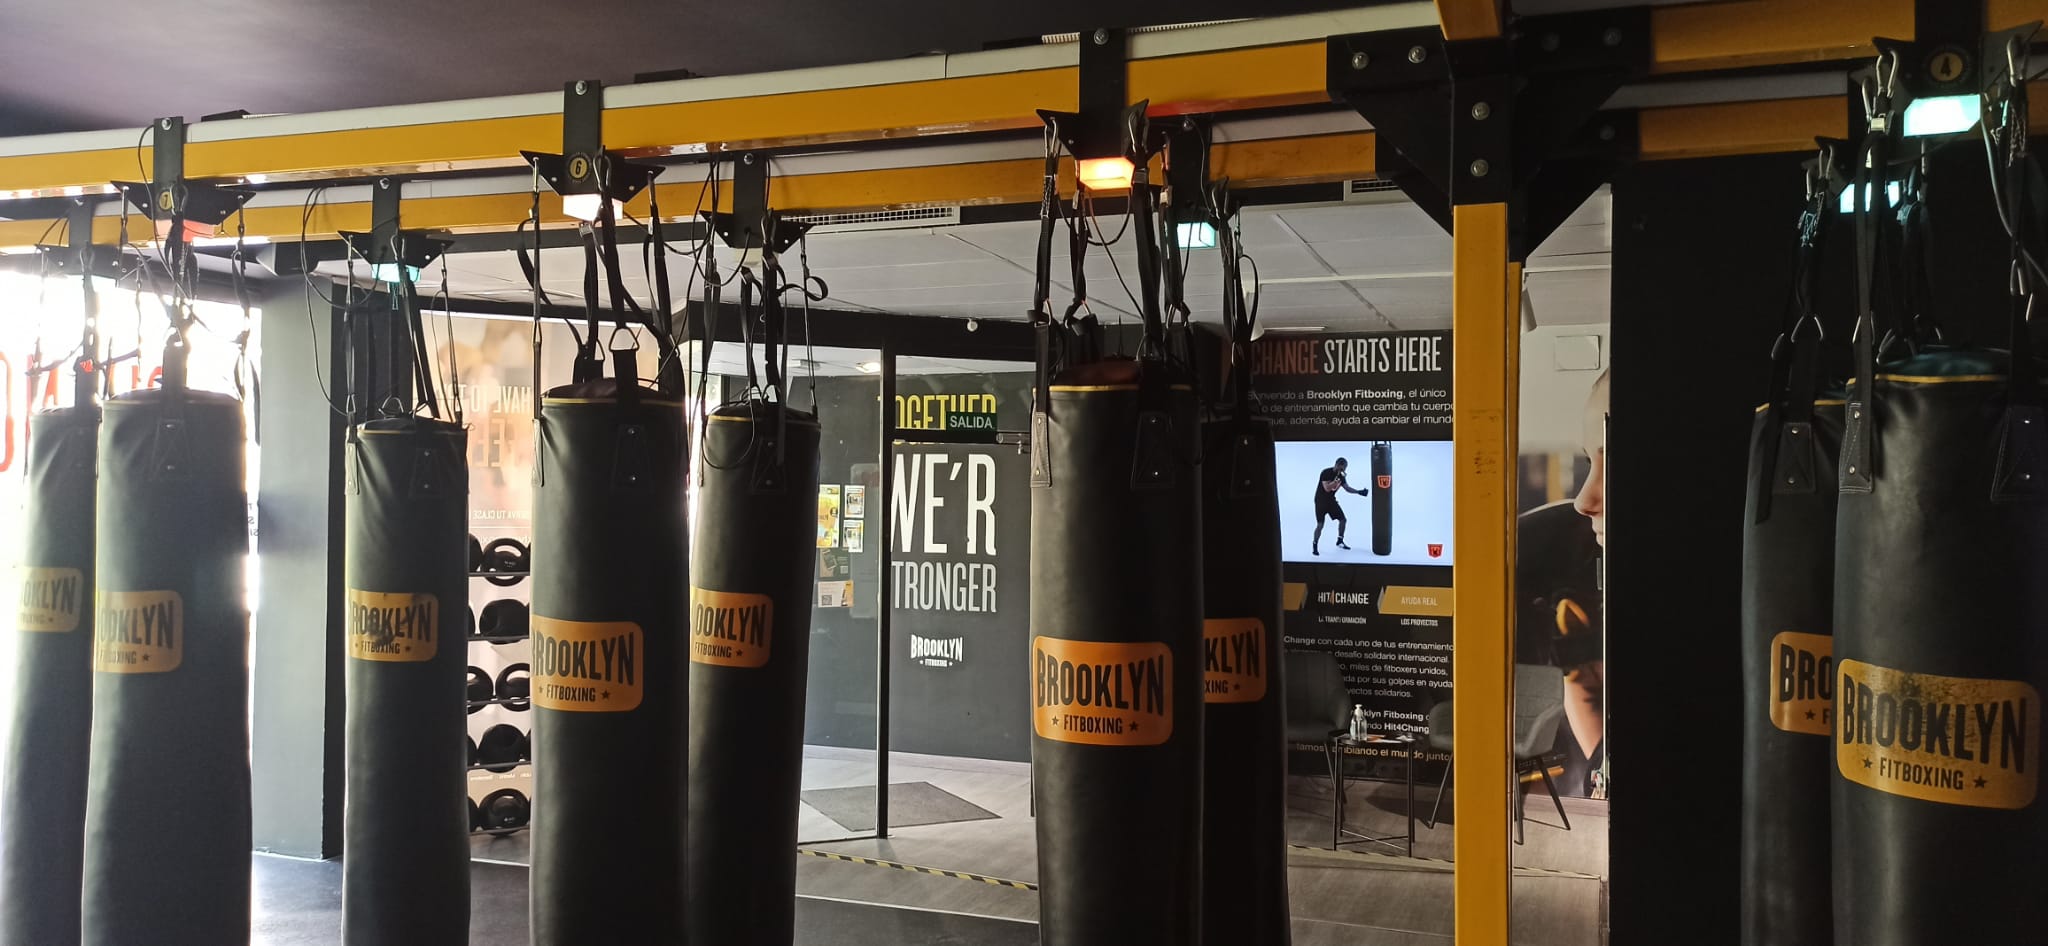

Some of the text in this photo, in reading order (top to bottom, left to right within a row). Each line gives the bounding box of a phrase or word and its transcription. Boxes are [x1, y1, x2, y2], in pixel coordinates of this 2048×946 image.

[1940, 56, 1952, 76] 4
[575, 160, 582, 175] 6
[1251, 336, 1442, 375] CHANGE STARTS HERE
[1307, 389, 1352, 400] Brooklyn
[1355, 389, 1406, 400] Fitboxing,
[1408, 388, 1417, 398] el
[1419, 388, 1447, 398] único
[1270, 404, 1283, 412] de
[1284, 403, 1350, 412] entrenamiento
[1352, 403, 1371, 413] que
[1373, 402, 1408, 411] cambia
[1411, 402, 1421, 411] tu
[950, 415, 993, 429] SALIDA
[1290, 416, 1329, 425] además,
[1332, 416, 1360, 426] ayuda
[1371, 415, 1410, 424] cambiar
[1412, 415, 1421, 424] el
[23, 576, 76, 614] OKLYN
[891, 560, 997, 613] TRONGER
[1422, 597, 1438, 606] REAL
[99, 600, 174, 650] OOKLYN
[351, 600, 432, 643] ROOKLYN
[695, 603, 766, 648] OOKLYN
[910, 634, 963, 663] BROOKLYN
[1283, 635, 1316, 646] Change
[1333, 637, 1353, 646] cada
[1371, 639, 1382, 648] de
[1384, 640, 1396, 649] tus
[1204, 628, 1260, 678] KLYN
[1363, 651, 1396, 660] solidario
[1384, 664, 1417, 674] fitboxers
[1037, 647, 1164, 717] BROOKLYN
[1373, 677, 1386, 685] sus
[1388, 677, 1415, 686] golpes
[1428, 679, 1454, 689] ayuda
[546, 684, 596, 702] FITBOXING
[1063, 714, 1123, 735] FITBOXING
[1383, 710, 1424, 722] Fitboxing
[1843, 672, 2027, 774] BROOKLYN
[1384, 722, 1430, 735] Hit4Chang
[1380, 748, 1389, 757] el
[1879, 756, 1964, 791] FITBOXING
